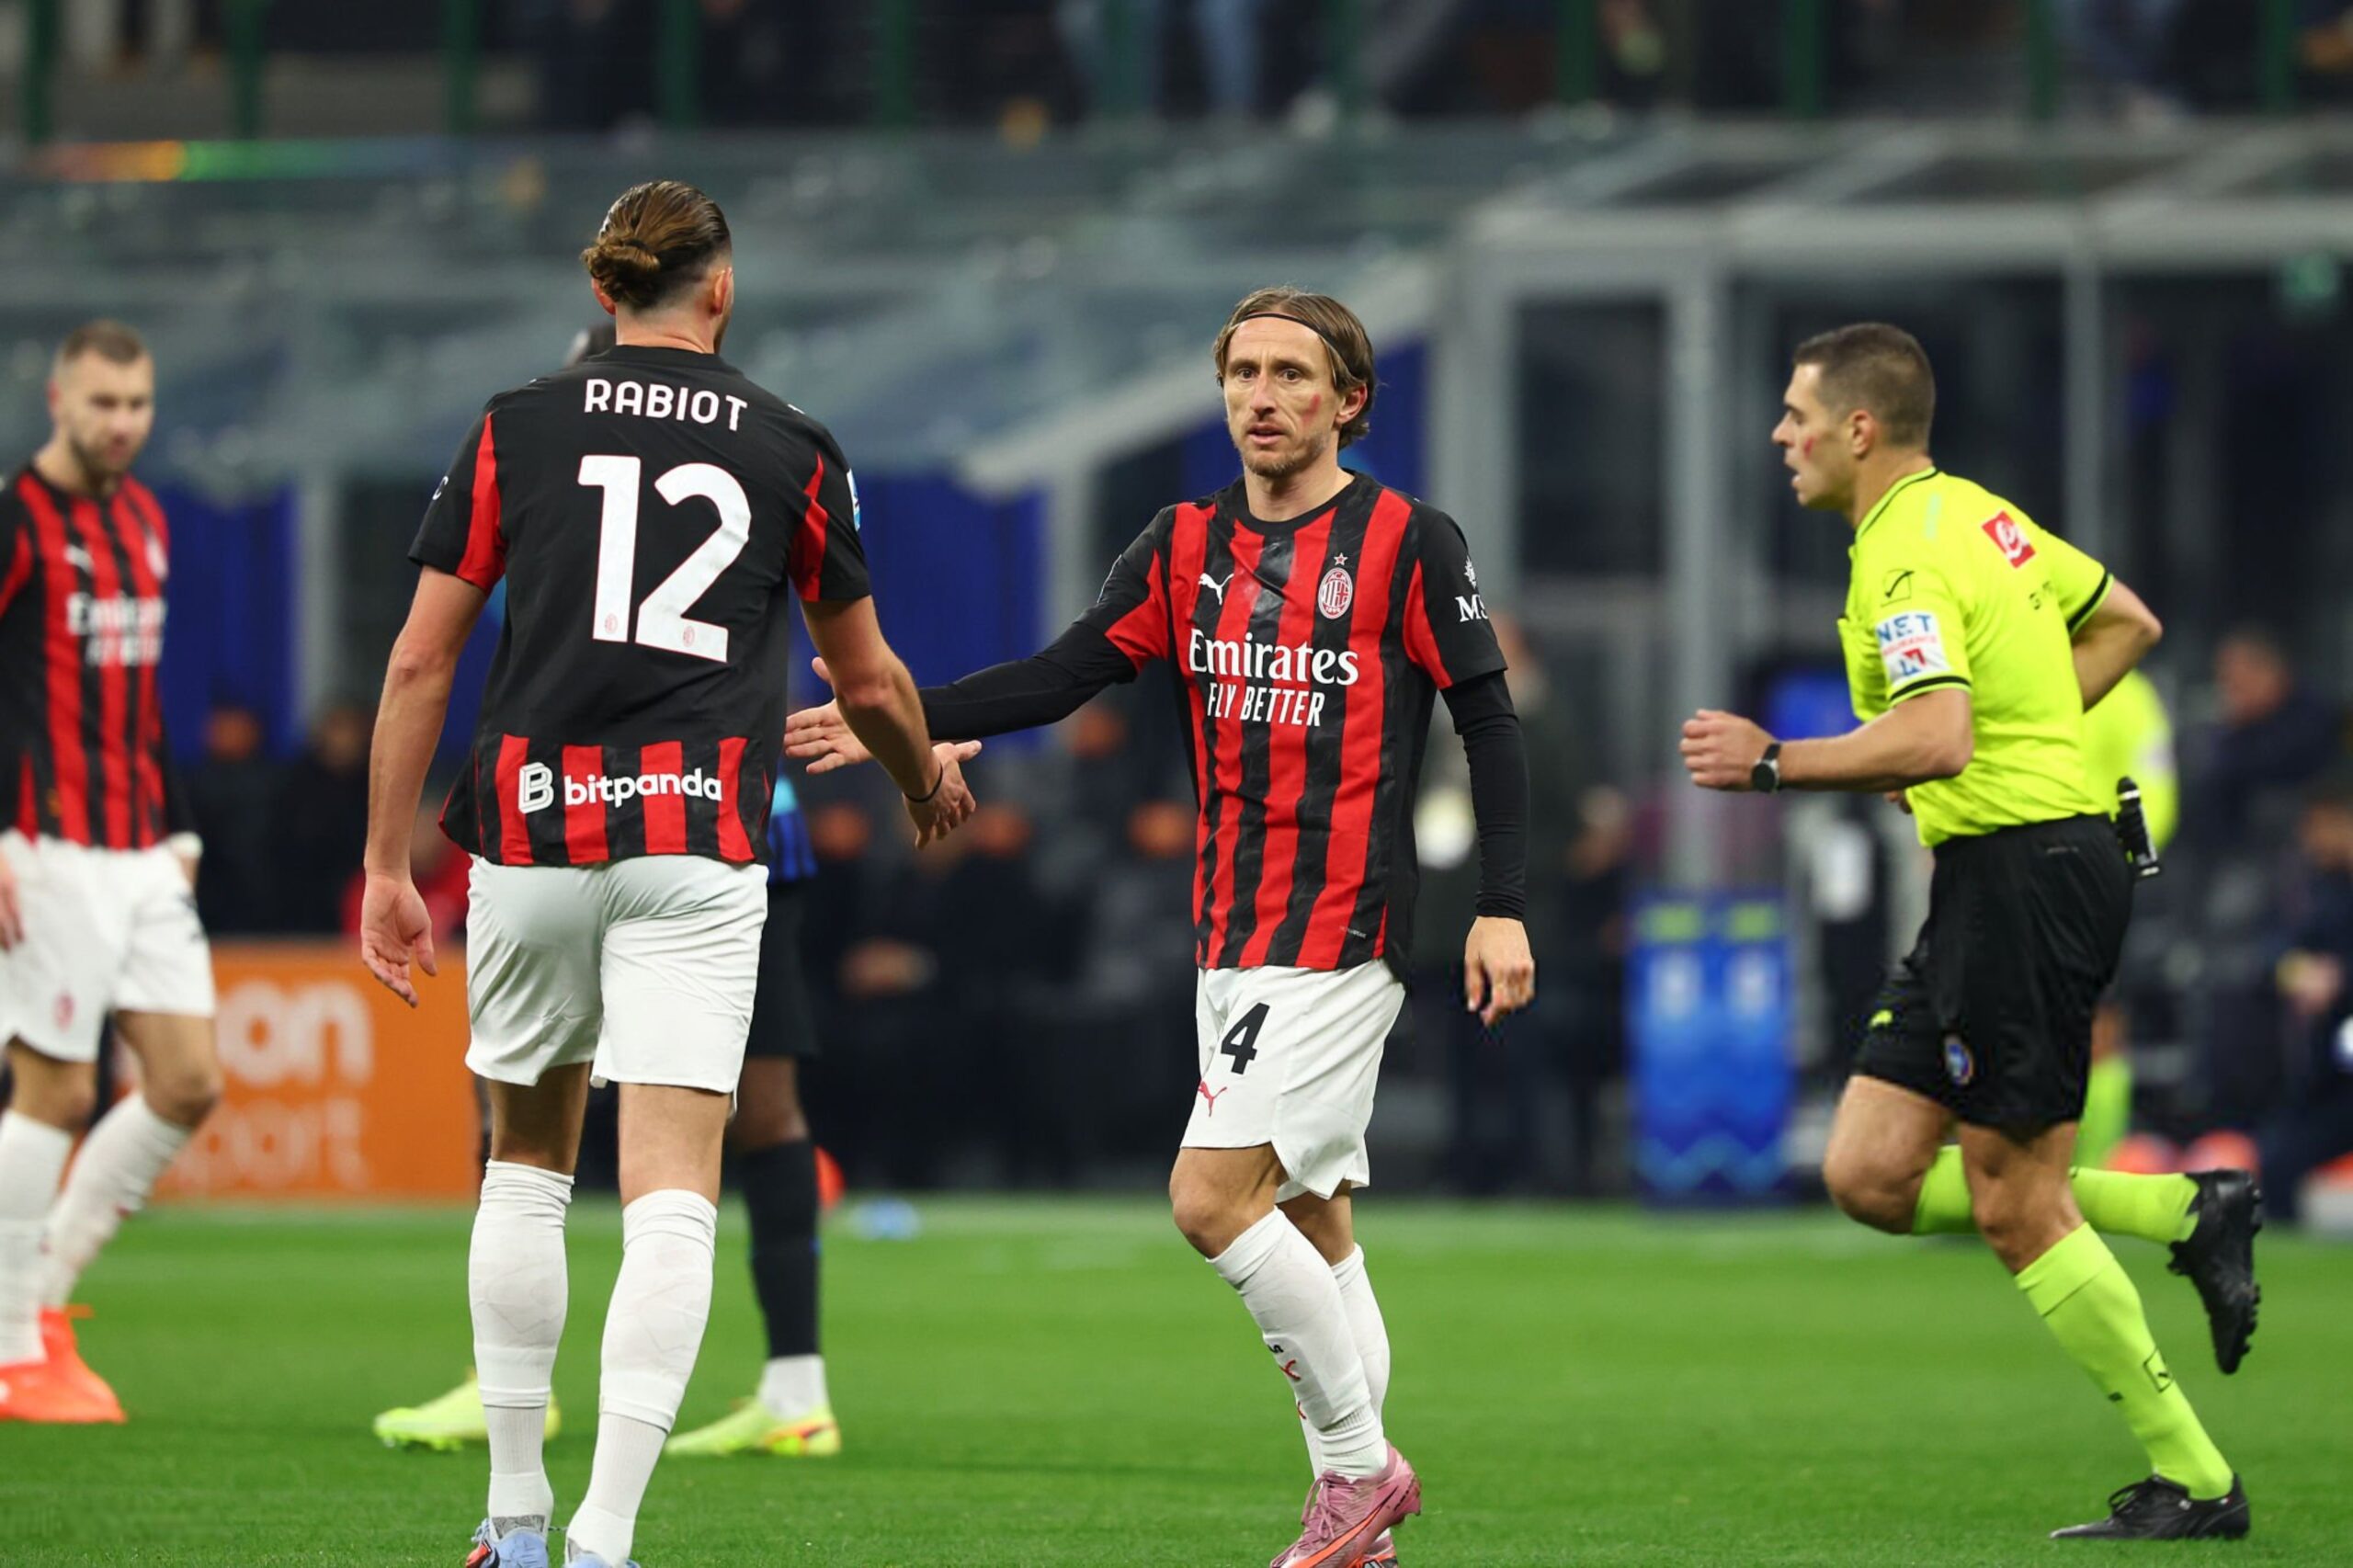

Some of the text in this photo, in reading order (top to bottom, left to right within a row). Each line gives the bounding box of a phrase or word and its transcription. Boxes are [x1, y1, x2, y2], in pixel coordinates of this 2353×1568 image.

[584, 378, 748, 432] RABIOT
[577, 453, 753, 664] 12
[1876, 614, 1932, 642] NET
[1188, 628, 1359, 686] Emirates
[1207, 682, 1325, 727] FLY BETTER
[563, 767, 723, 808] bitpanda
[1221, 1002, 1270, 1075] 4
